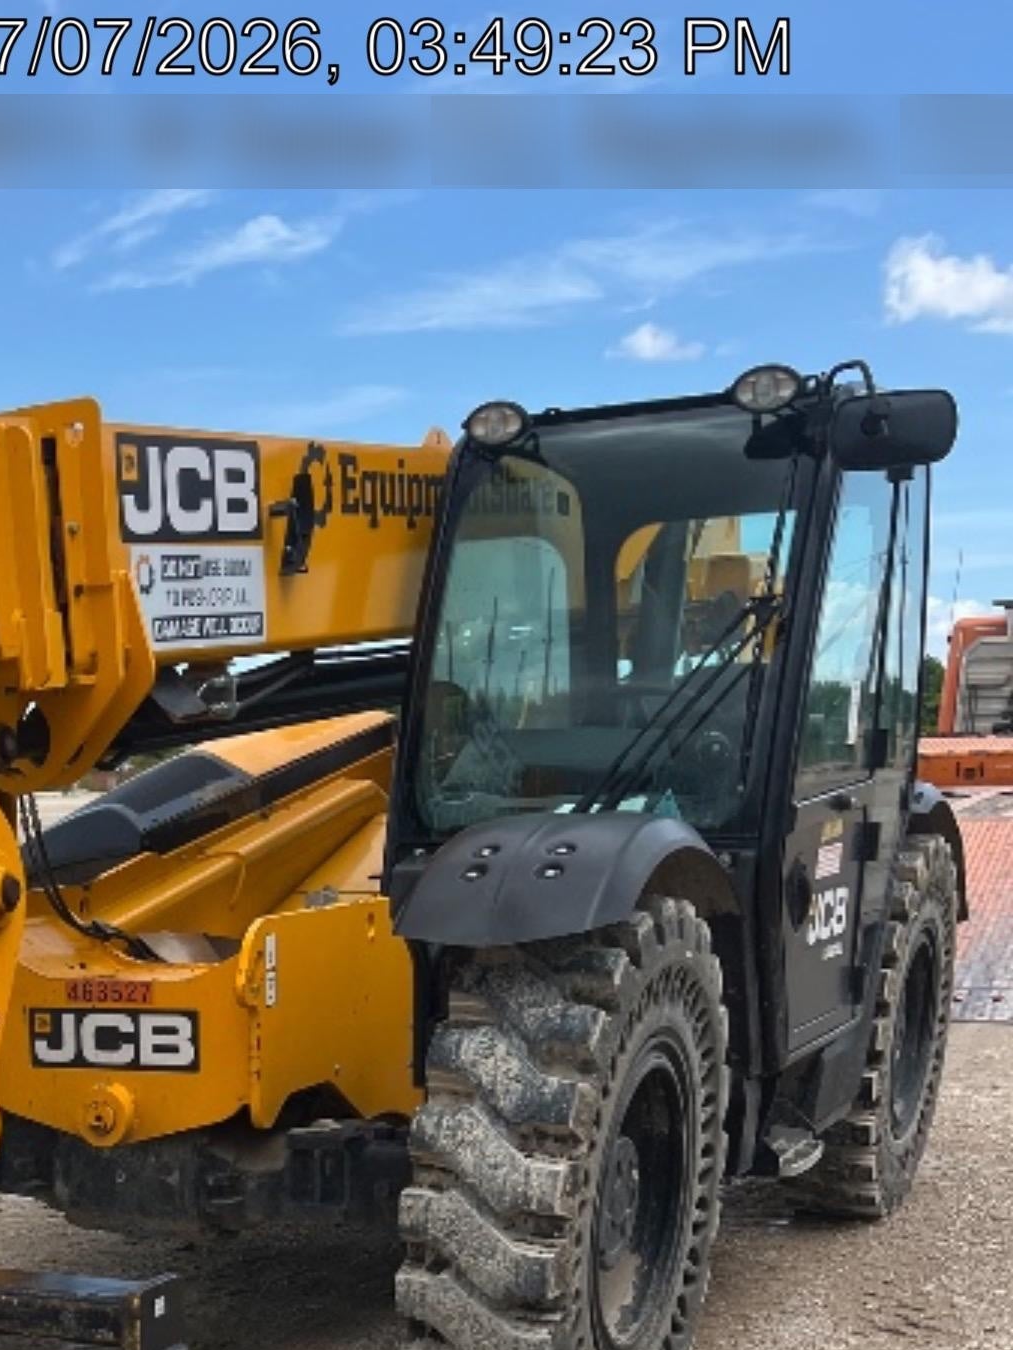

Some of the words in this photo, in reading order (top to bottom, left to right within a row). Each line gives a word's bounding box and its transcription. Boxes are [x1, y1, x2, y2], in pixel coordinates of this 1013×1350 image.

[122, 445, 259, 535] JCB
[153, 617, 201, 640] DAMAGE
[202, 616, 228, 638] WILL
[806, 886, 849, 946] JCB
[67, 980, 151, 1004] 463527
[34, 1012, 196, 1069] JCB
